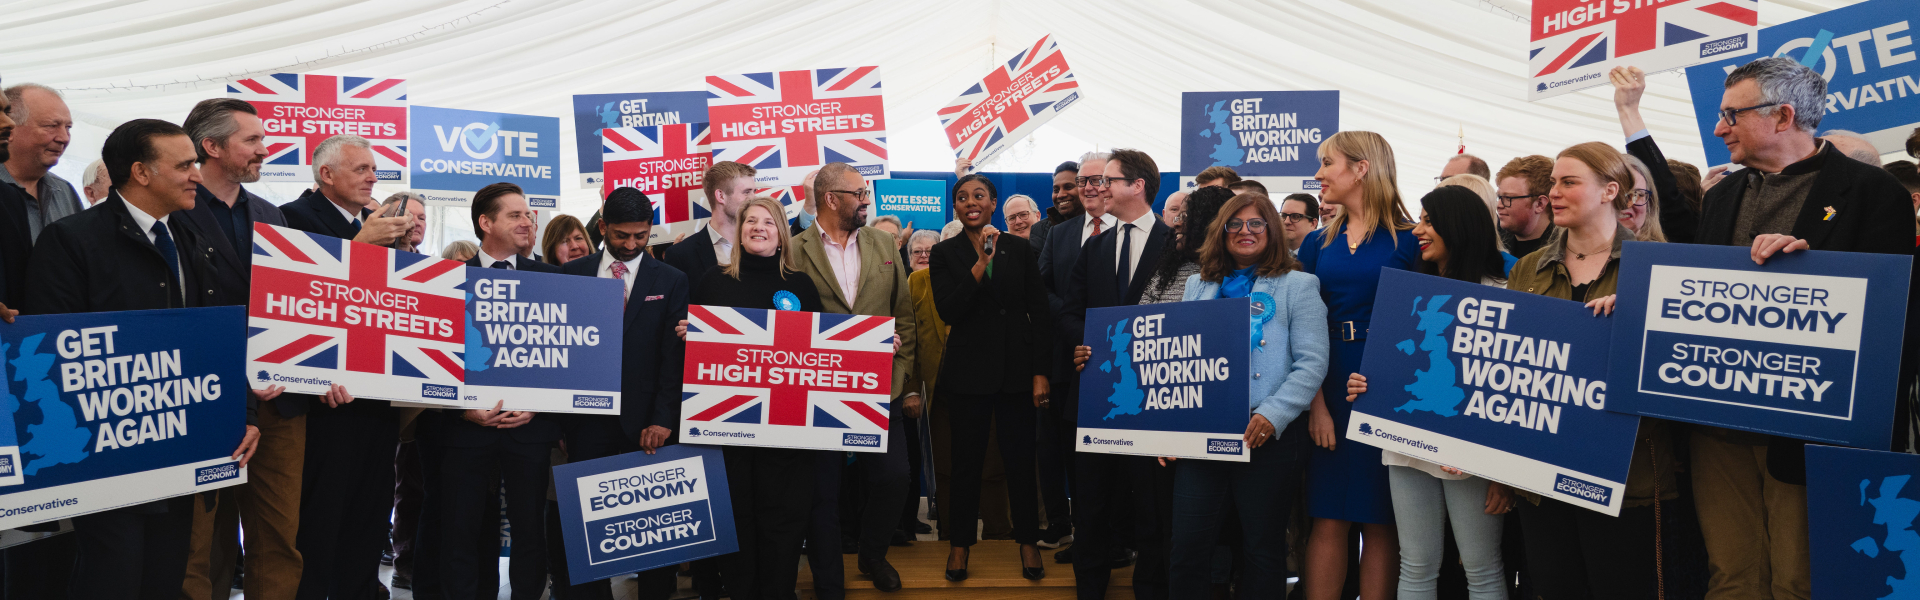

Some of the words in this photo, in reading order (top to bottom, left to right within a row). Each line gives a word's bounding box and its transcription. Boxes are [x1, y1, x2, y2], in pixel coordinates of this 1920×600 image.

[1543, 0, 1606, 34] HIGH
[1702, 41, 1745, 56] ECONOMY
[1704, 36, 1742, 50] STRONGER
[1549, 72, 1602, 89] Conservatives
[955, 111, 993, 143] HIGH
[994, 65, 1061, 115] STREETS
[972, 71, 1034, 118] STRONGER
[273, 105, 366, 120] STRONGER
[619, 99, 648, 115] GET
[752, 102, 842, 119] STRONGER
[1230, 98, 1262, 114] GET
[302, 119, 397, 137] STREETS
[622, 111, 680, 128] BRITAIN
[721, 120, 776, 138] HIGH
[781, 113, 875, 134] STREETS
[1232, 112, 1297, 131] BRITAIN
[433, 122, 538, 160] VOTE
[1239, 128, 1321, 147] WORKING
[639, 156, 708, 175] STRONGER
[1246, 146, 1299, 164] AGAIN
[420, 158, 552, 179] CONSERVATIVE
[613, 175, 658, 192] HIGH
[880, 204, 941, 212] CONSERVATIVES
[881, 195, 909, 204] VOTE
[910, 196, 941, 205] ESSEX
[309, 280, 419, 312] STRONGER
[474, 278, 520, 300] GET
[1679, 279, 1829, 307] STRONGER
[266, 293, 338, 323] HIGH
[344, 306, 454, 338] STREETS
[475, 301, 567, 323] BRITAIN
[1457, 297, 1515, 330] GET
[1660, 298, 1848, 334] ECONOMY
[485, 323, 600, 347] WORKING
[1132, 313, 1165, 339] GET
[56, 325, 118, 360] GET
[1133, 334, 1201, 362] BRITAIN
[1452, 326, 1571, 371] BRITAIN
[494, 347, 569, 369] AGAIN
[736, 348, 843, 368] STRONGER
[1671, 342, 1821, 375] STRONGER
[60, 349, 182, 393] BRITAIN
[273, 373, 332, 387] Conservatives
[697, 363, 761, 383] HIGH
[768, 367, 879, 390] STREETS
[1139, 357, 1229, 386] WORKING
[426, 385, 454, 394] STRONGER
[1461, 357, 1607, 410] WORKING
[1658, 362, 1834, 403] COUNTRY
[77, 373, 222, 422] WORKING
[423, 389, 457, 399] ECONOMY
[1145, 385, 1203, 411] AGAIN
[1464, 390, 1562, 435] AGAIN
[94, 409, 188, 453] AGAIN
[703, 429, 756, 439] Conservatives
[1093, 437, 1134, 447] Conservatives
[1374, 428, 1439, 453] Conservatives
[1208, 445, 1241, 453] ECONOMY
[1211, 440, 1239, 448] STRONGER
[197, 468, 238, 483] ECONOMY
[200, 464, 235, 476] STRONGER
[598, 467, 686, 494] STRONGER
[590, 478, 698, 512] ECONOMY
[1557, 483, 1608, 503] ECONOMY
[1561, 477, 1605, 495] STRONGER
[0, 497, 79, 518] Conservatives
[605, 509, 693, 537] STRONGER
[599, 520, 701, 554] COUNTRY
